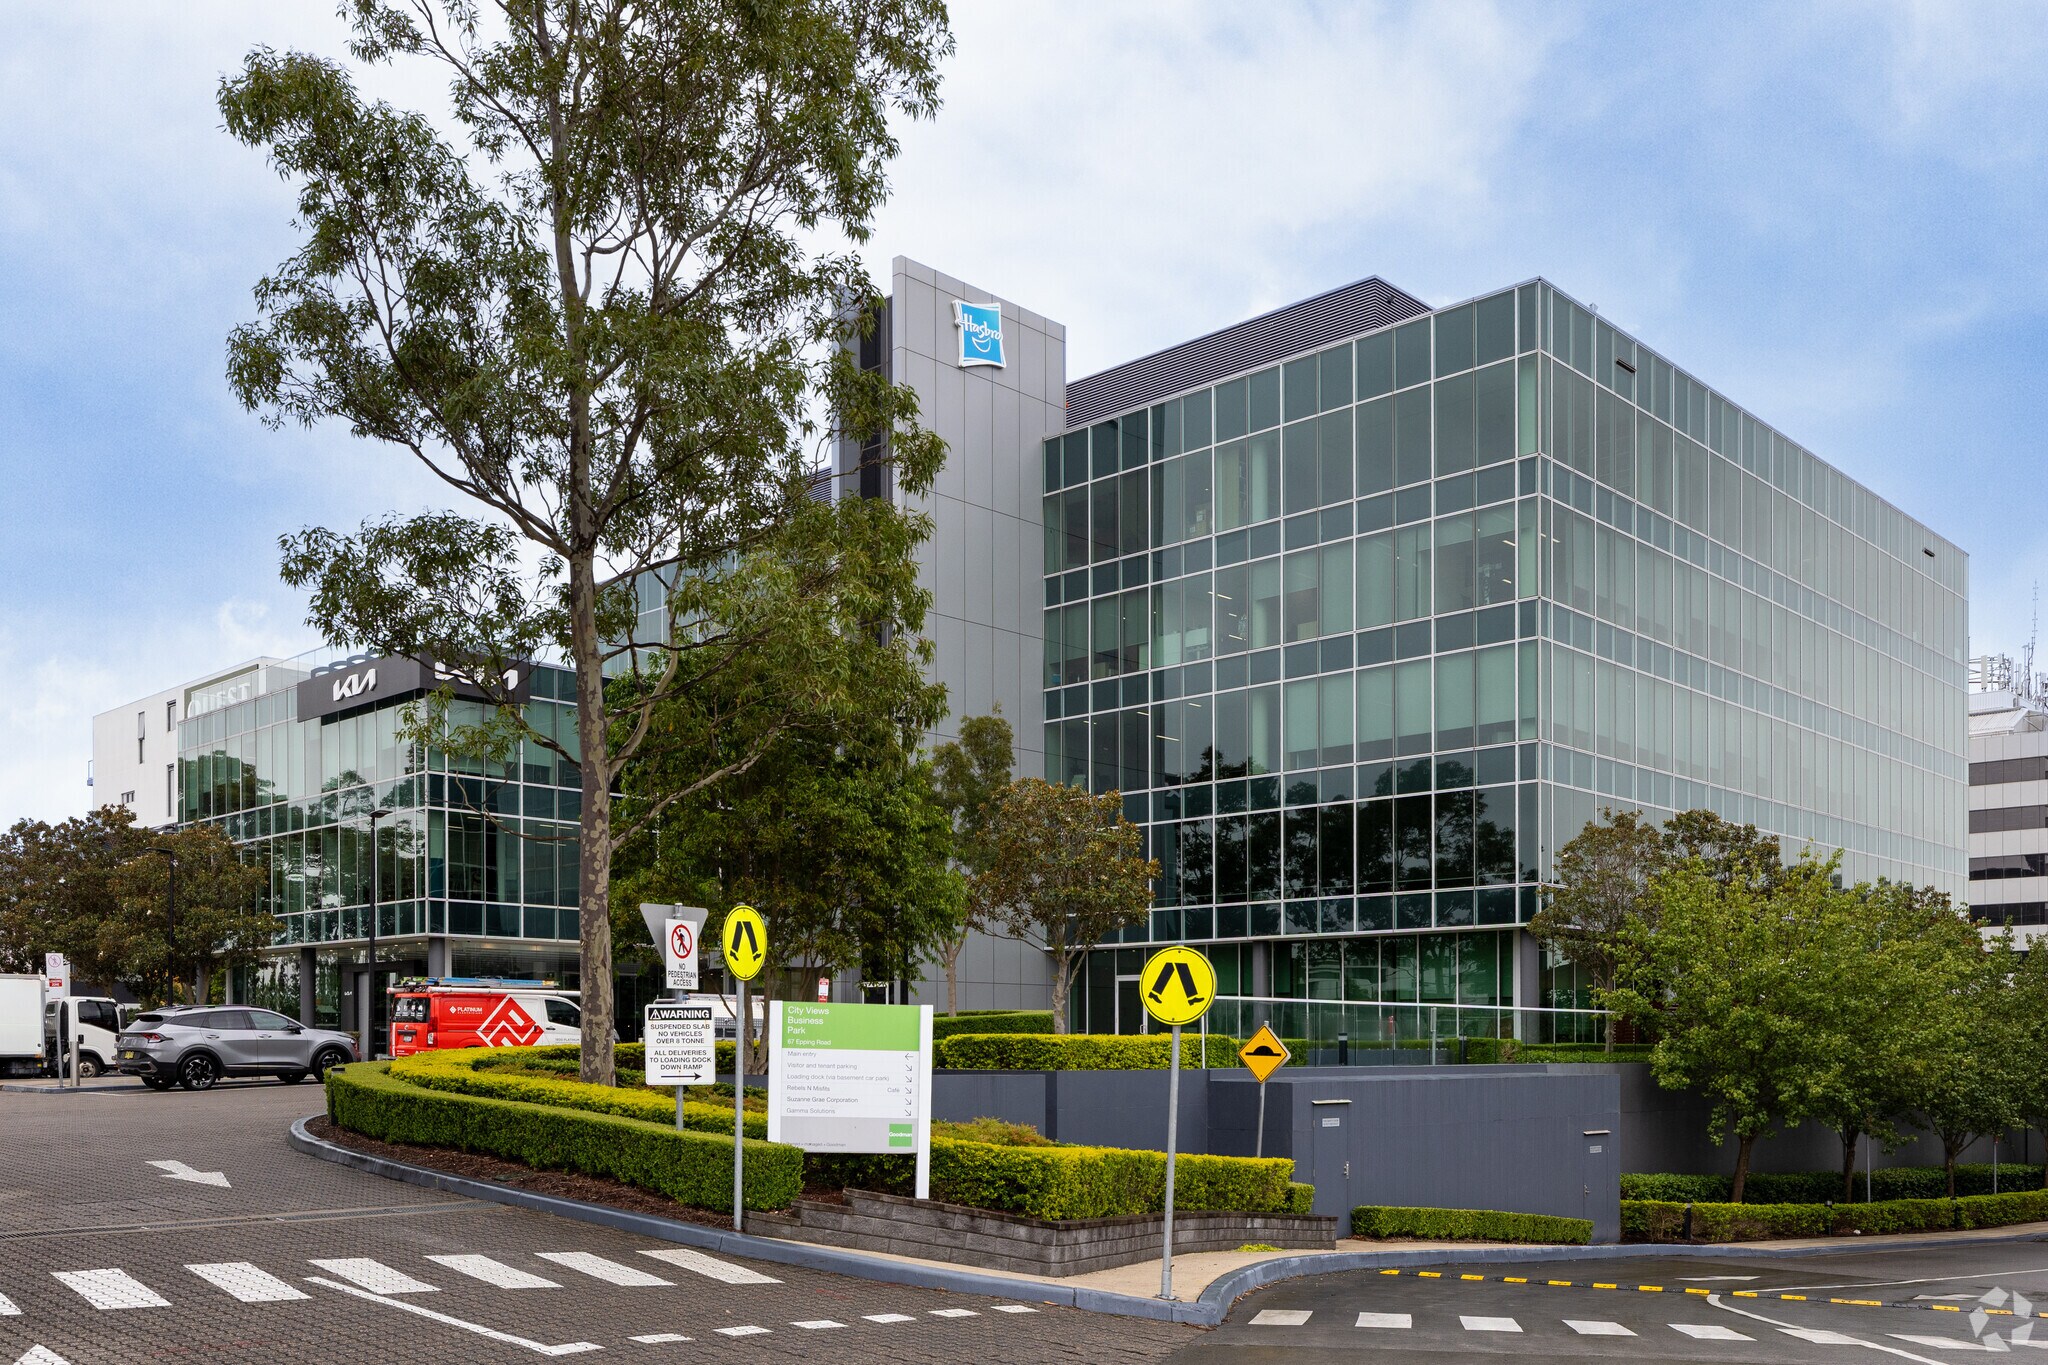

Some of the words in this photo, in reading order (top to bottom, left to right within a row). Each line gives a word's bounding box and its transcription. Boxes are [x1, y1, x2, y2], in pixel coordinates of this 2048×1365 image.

[955, 313, 1003, 340] Hasbro
[332, 668, 377, 701] KIA
[668, 970, 696, 978] PEDESTRIAN
[660, 1009, 710, 1019] WARNING
[788, 1006, 804, 1015] City
[806, 1006, 830, 1014] Views
[788, 1016, 824, 1024] Business
